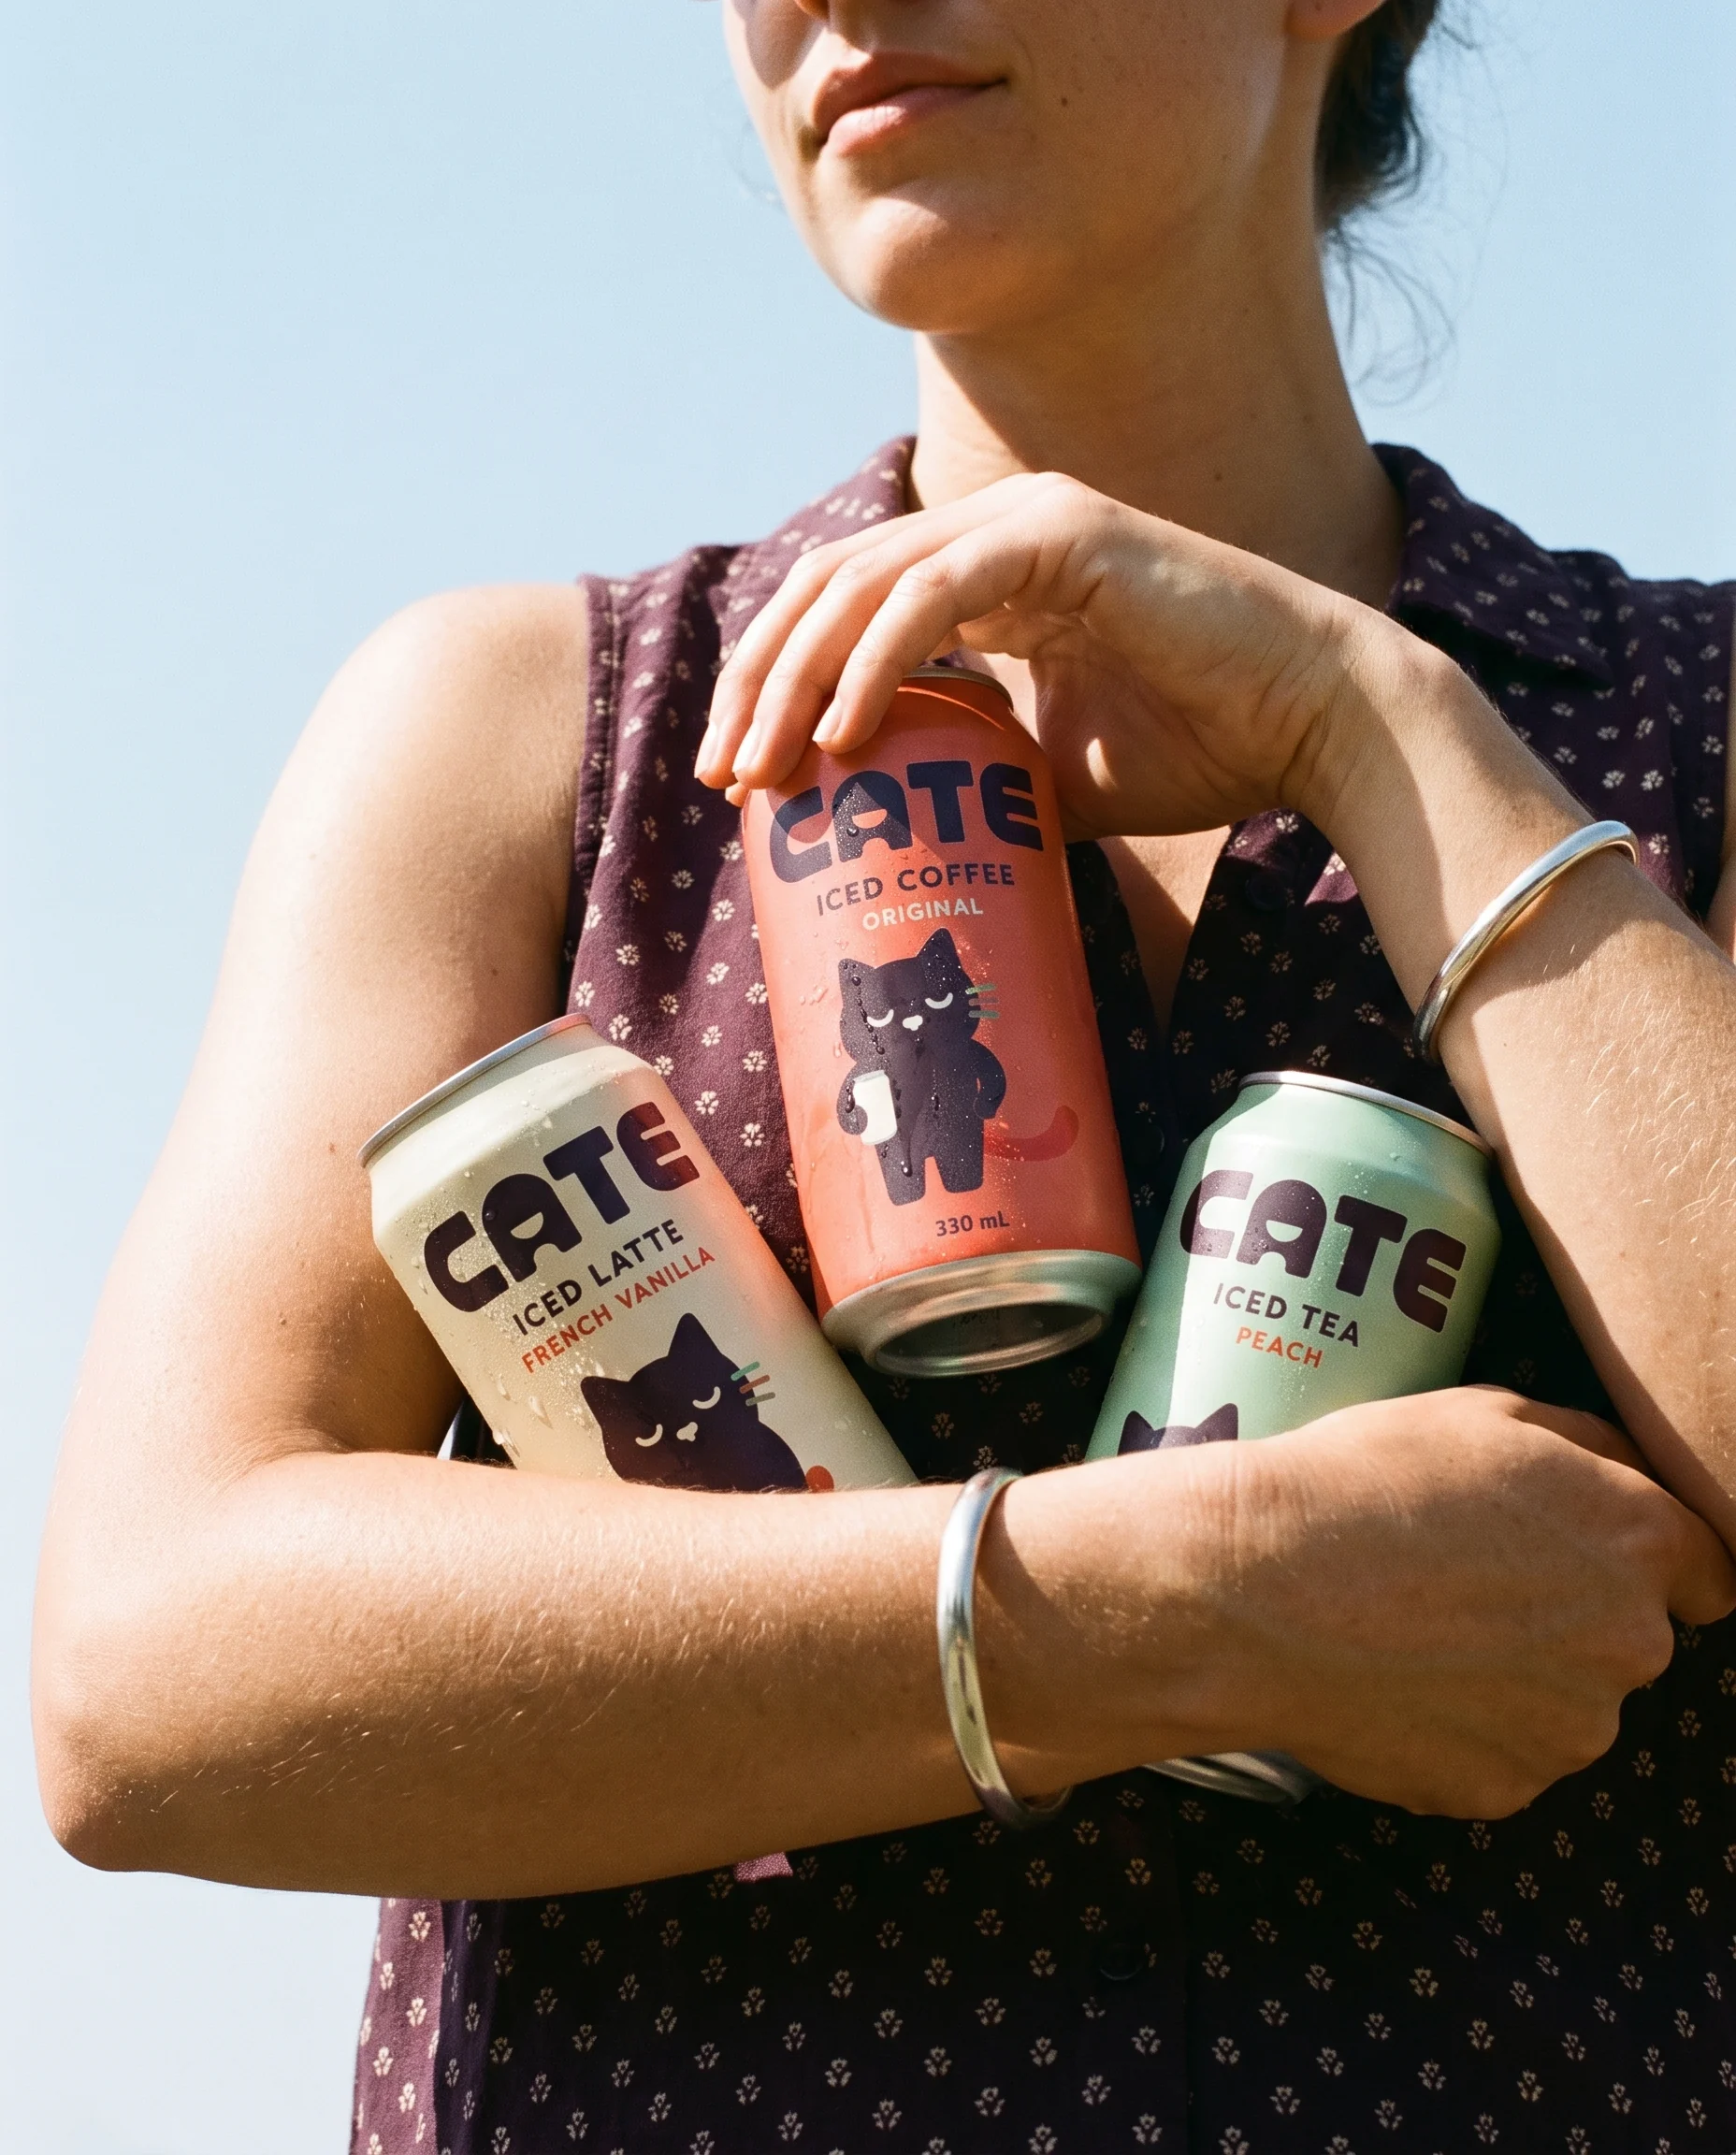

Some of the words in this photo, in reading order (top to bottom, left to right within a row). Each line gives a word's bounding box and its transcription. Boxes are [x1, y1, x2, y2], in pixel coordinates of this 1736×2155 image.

[769, 759, 1044, 883] CATE
[817, 876, 883, 917] ICED
[896, 862, 1015, 891] COFFEE
[861, 897, 983, 931] ORIGINAL
[424, 1101, 701, 1313] CATE
[935, 1214, 974, 1237] 330
[978, 1210, 1010, 1230] mL
[1179, 1169, 1467, 1334] CATE
[512, 1279, 583, 1336] ICED
[587, 1218, 685, 1288] LATTE
[521, 1304, 614, 1374] FRENCH
[615, 1246, 716, 1310] VANILLA
[1212, 1282, 1288, 1320] ICED
[1301, 1304, 1360, 1348] TEA
[1235, 1326, 1324, 1368] PEACH
